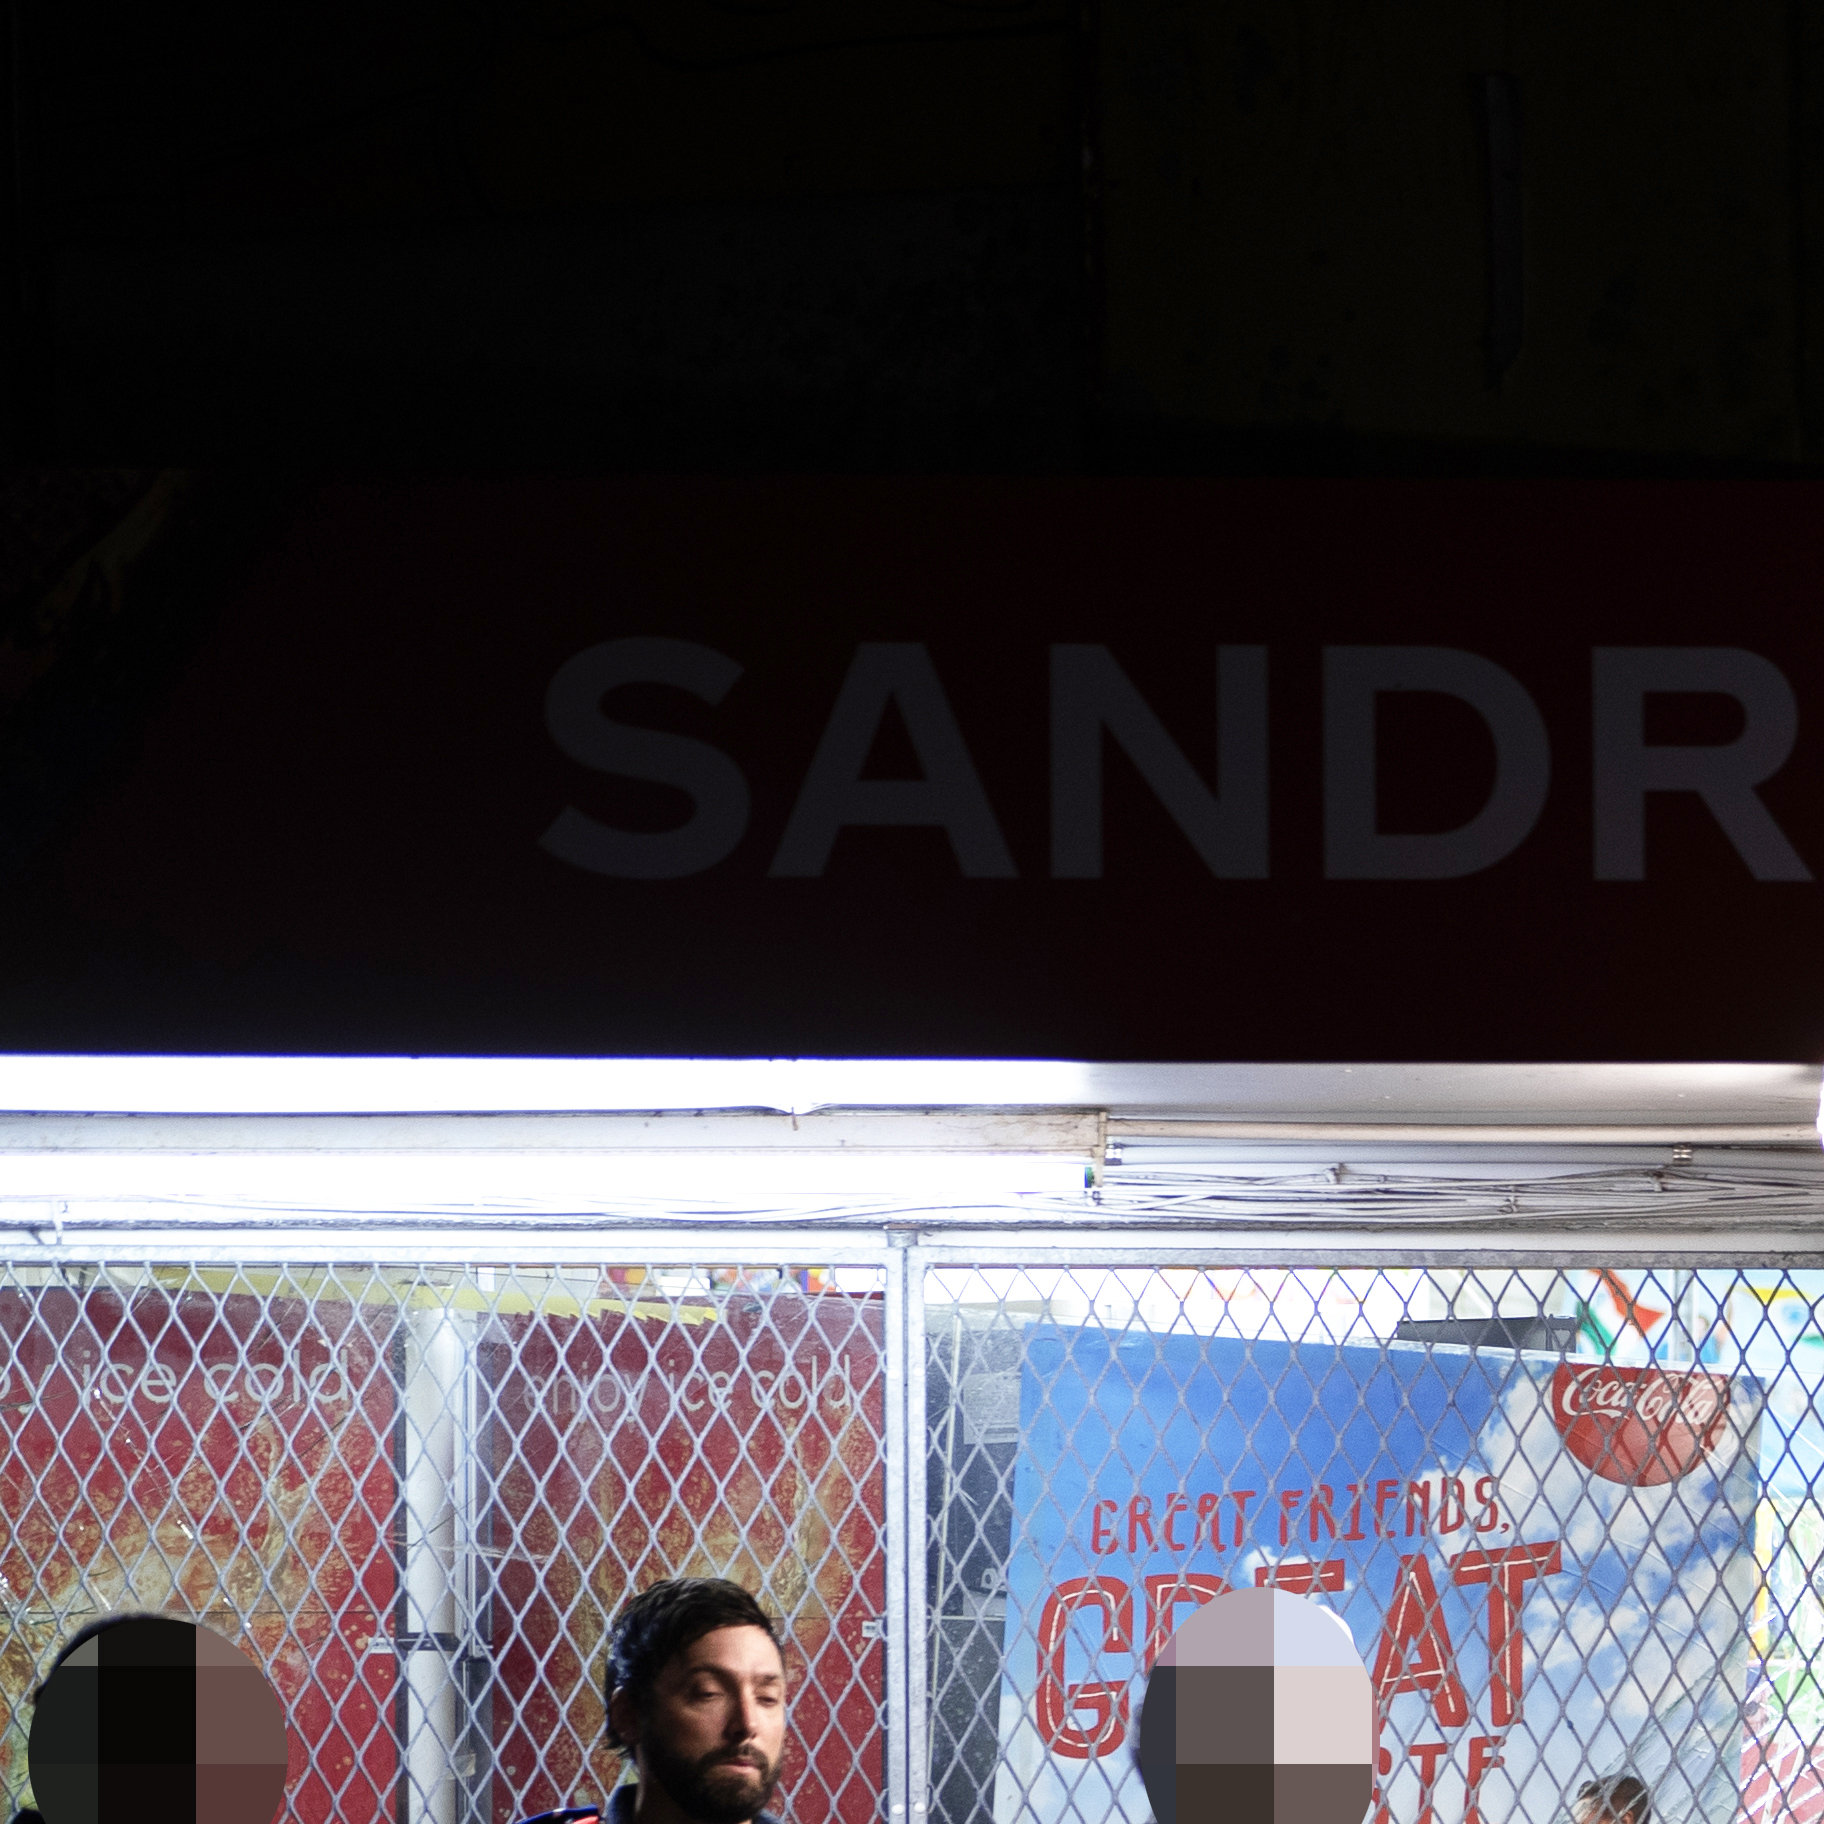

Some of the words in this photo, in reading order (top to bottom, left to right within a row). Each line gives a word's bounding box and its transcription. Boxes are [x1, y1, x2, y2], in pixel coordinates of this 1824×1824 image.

[82, 1349, 178, 1404] ice
[203, 1349, 348, 1404] cold
[523, 1360, 649, 1424] enjoy
[668, 1357, 735, 1413] ice
[751, 1353, 851, 1410] cold
[1561, 1366, 1729, 1427] Coca-Cola
[1091, 1488, 1257, 1557] GREAT
[1279, 1476, 1510, 1546] FRIENDS,
[1036, 1540, 1563, 1760] GAT
